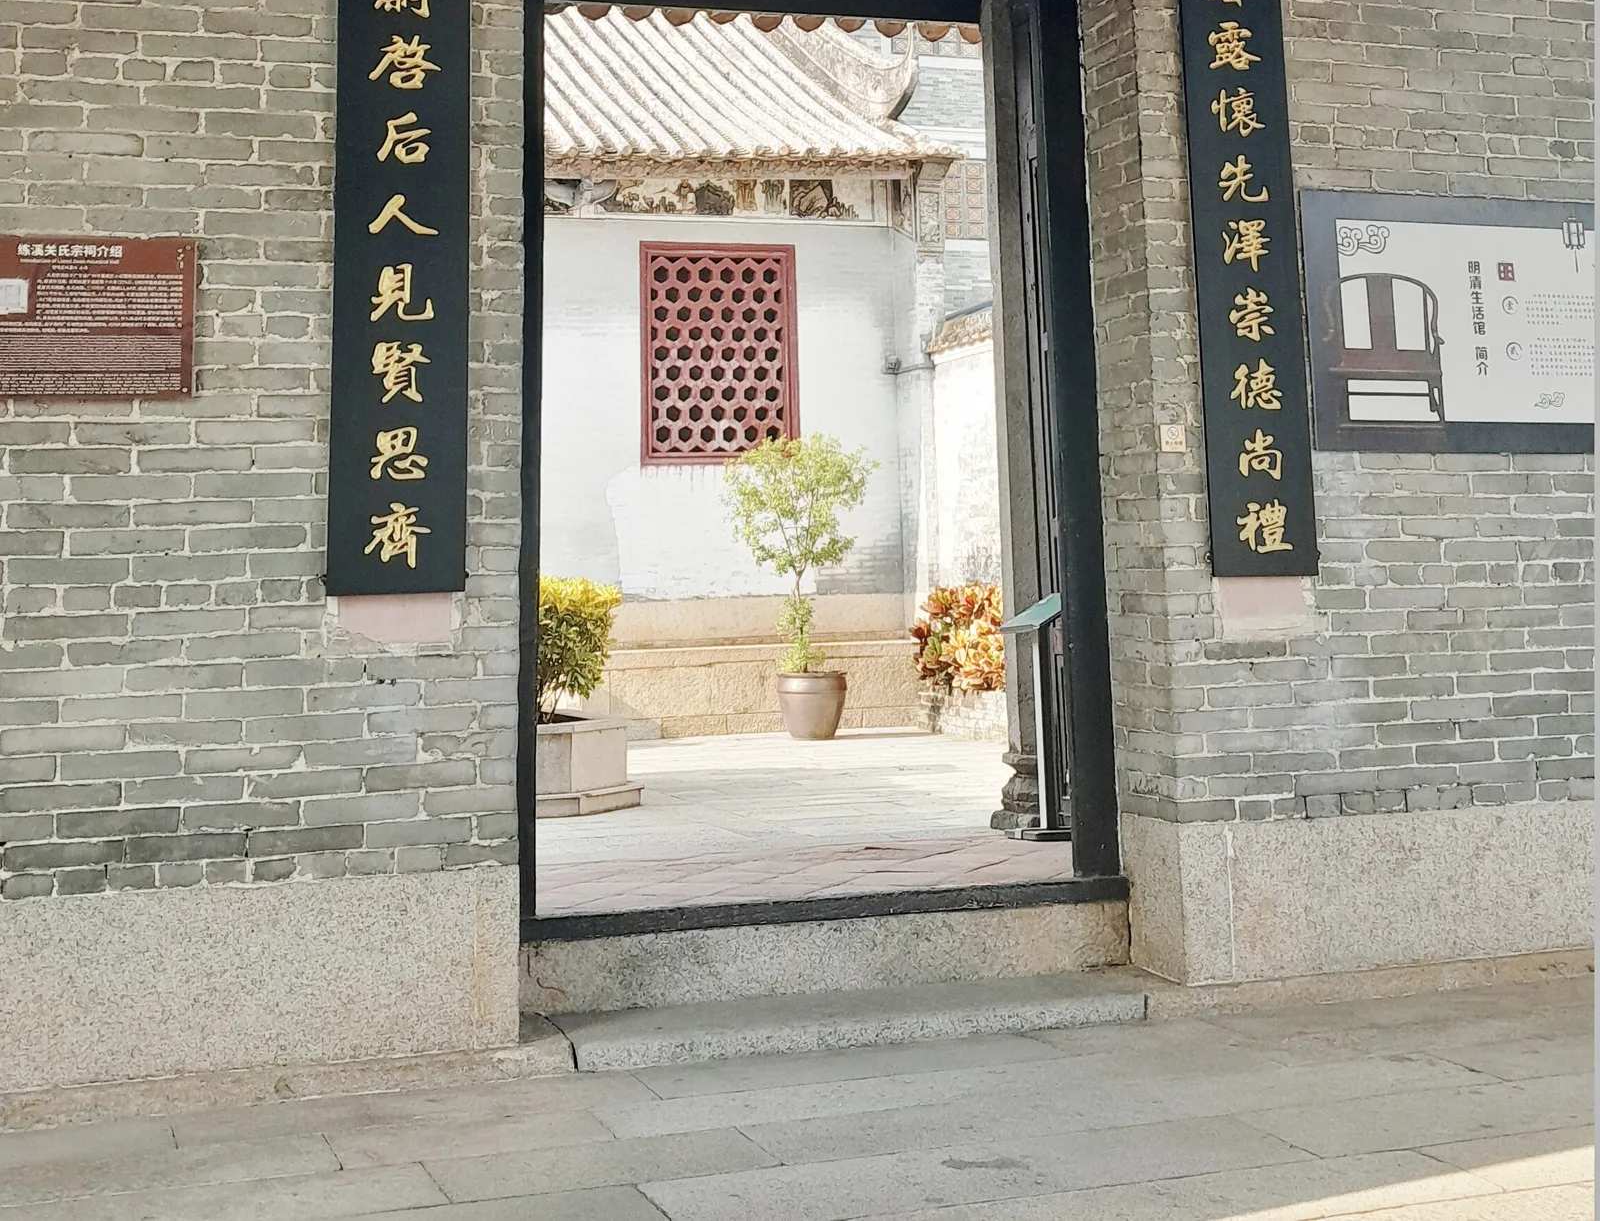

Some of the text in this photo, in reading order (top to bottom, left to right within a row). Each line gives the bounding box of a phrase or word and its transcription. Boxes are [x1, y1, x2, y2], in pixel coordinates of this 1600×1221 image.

[16, 243, 123, 258] 练溪关氏宗祠介绍
[1467, 261, 1489, 376] 明清生活馆 简介
